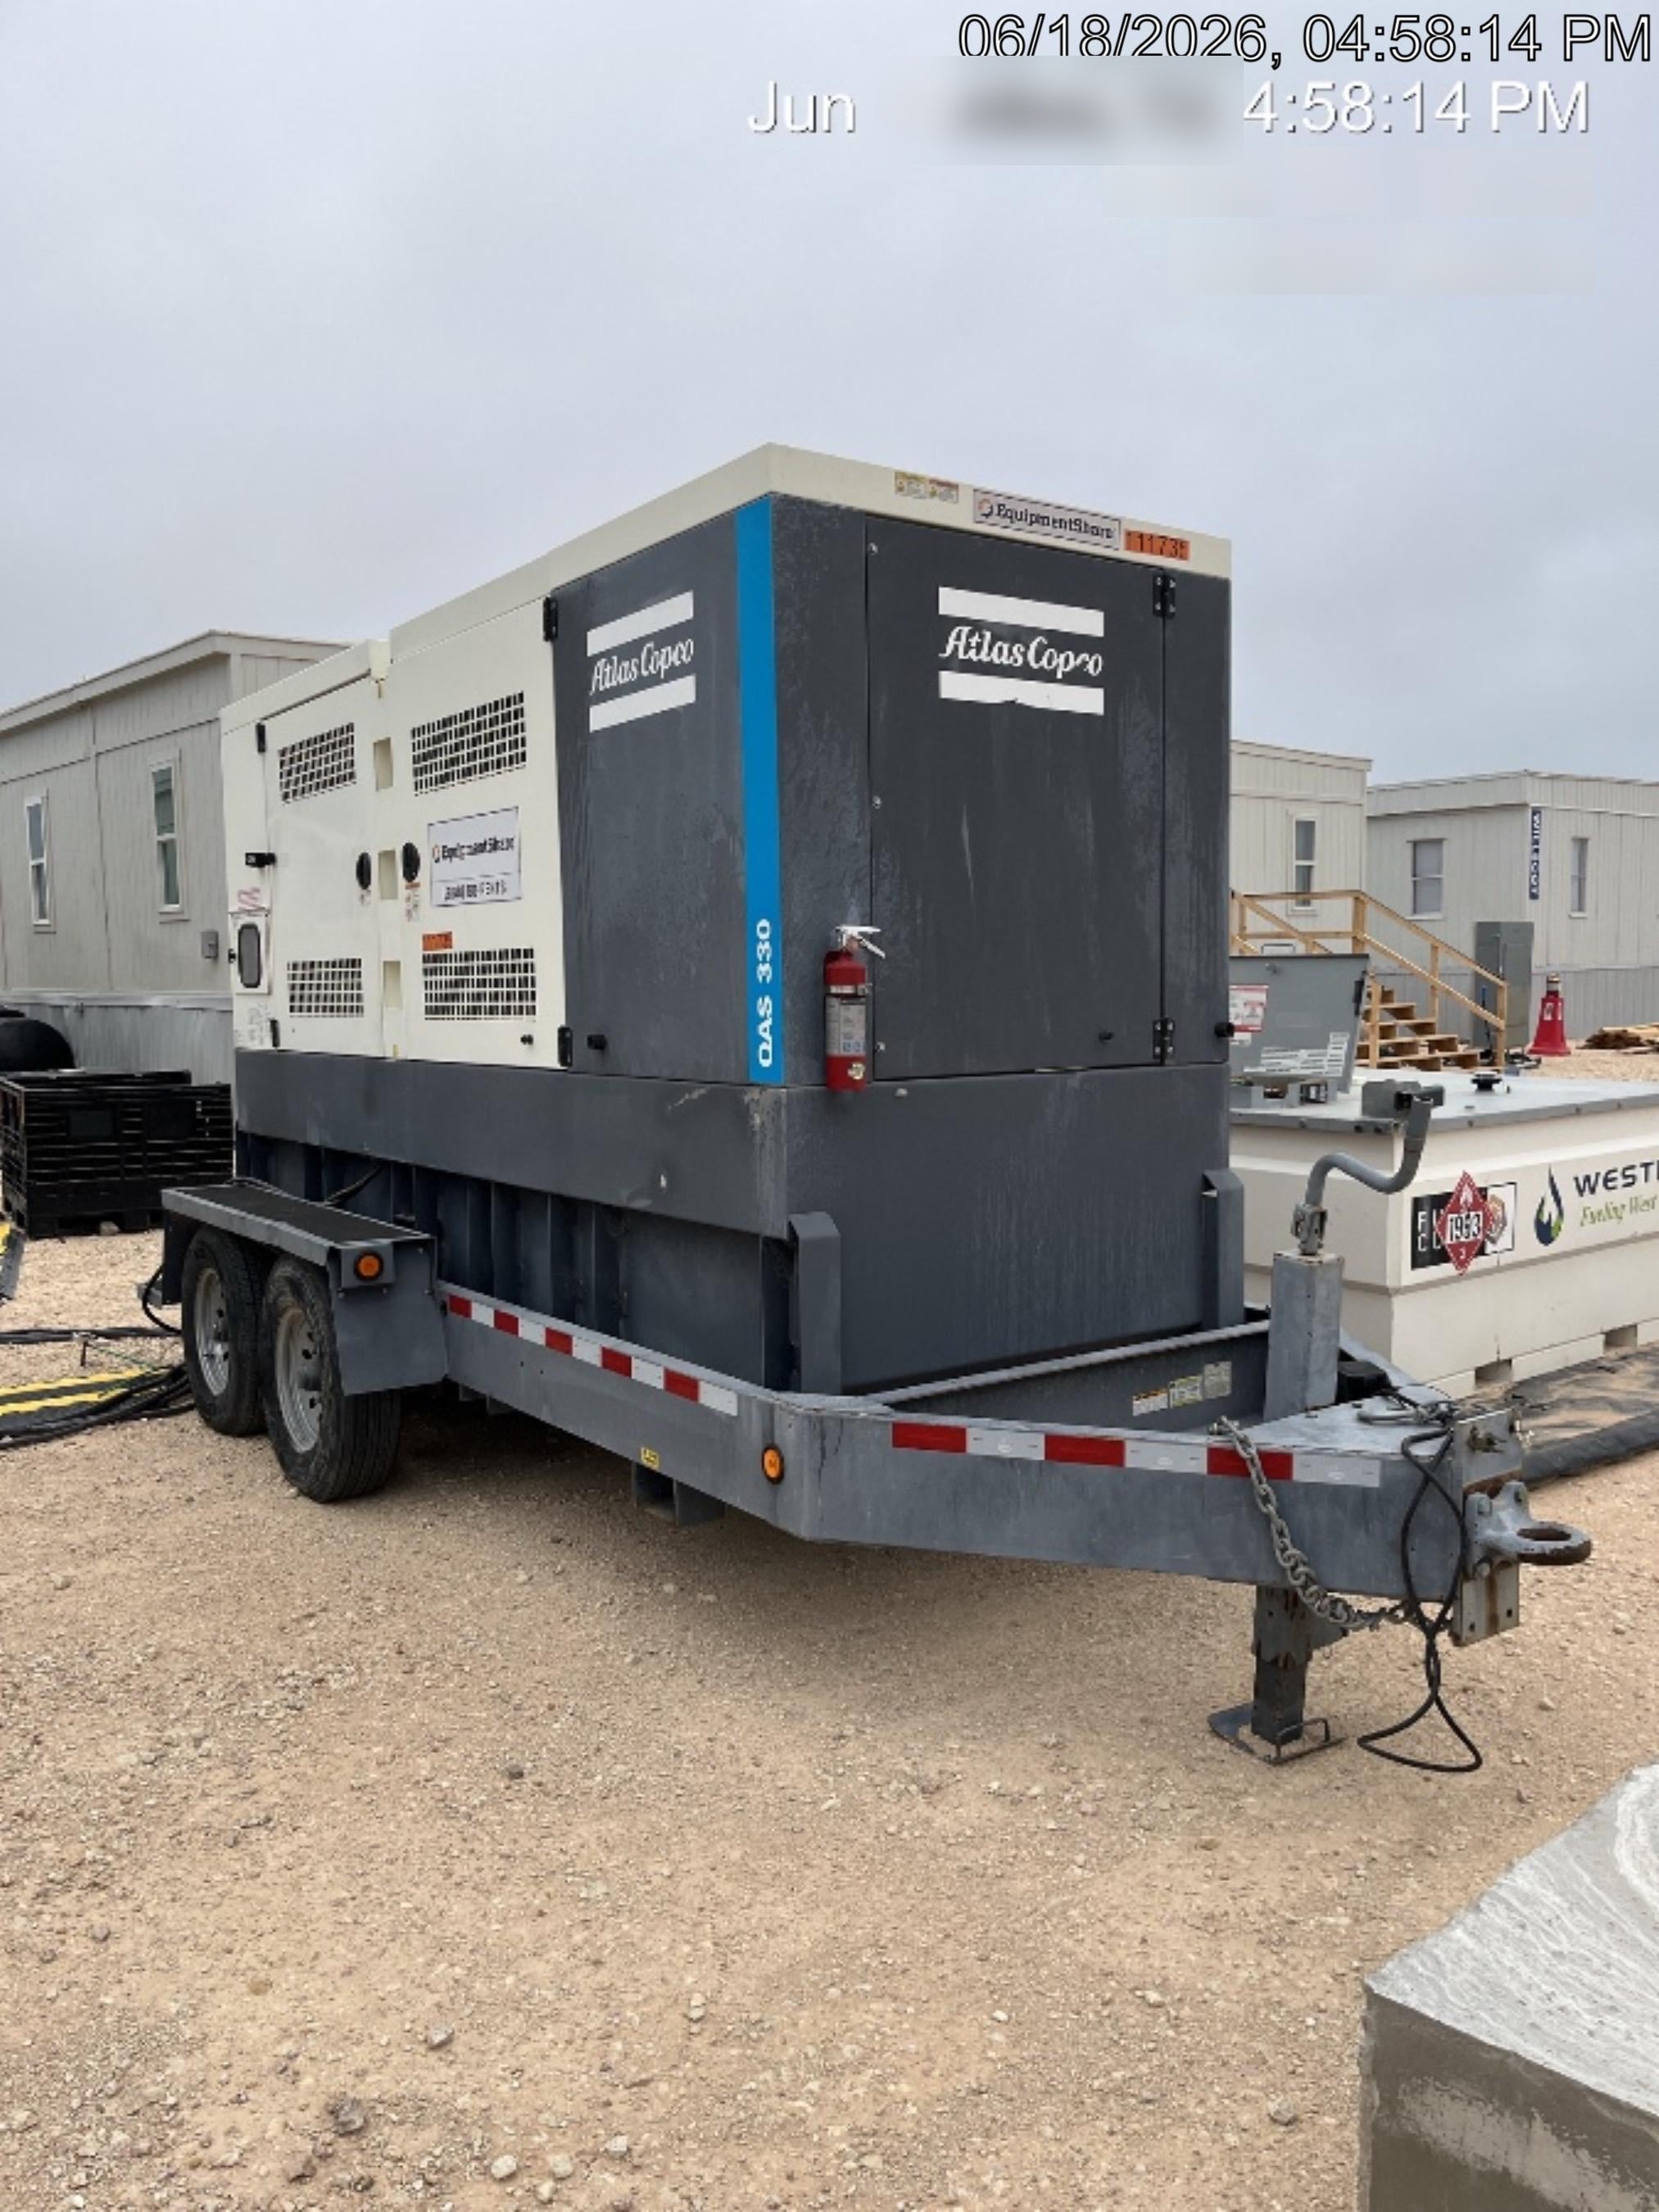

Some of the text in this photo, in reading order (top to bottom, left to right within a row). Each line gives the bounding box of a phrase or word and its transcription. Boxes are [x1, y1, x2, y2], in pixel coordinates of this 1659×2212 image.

[995, 502, 1114, 539] EquipmentShare
[589, 638, 695, 696] Atlas Copco
[938, 625, 1103, 679] Atlas Copco
[756, 918, 773, 1068] QAS 330
[1573, 1159, 1659, 1198] WEST
